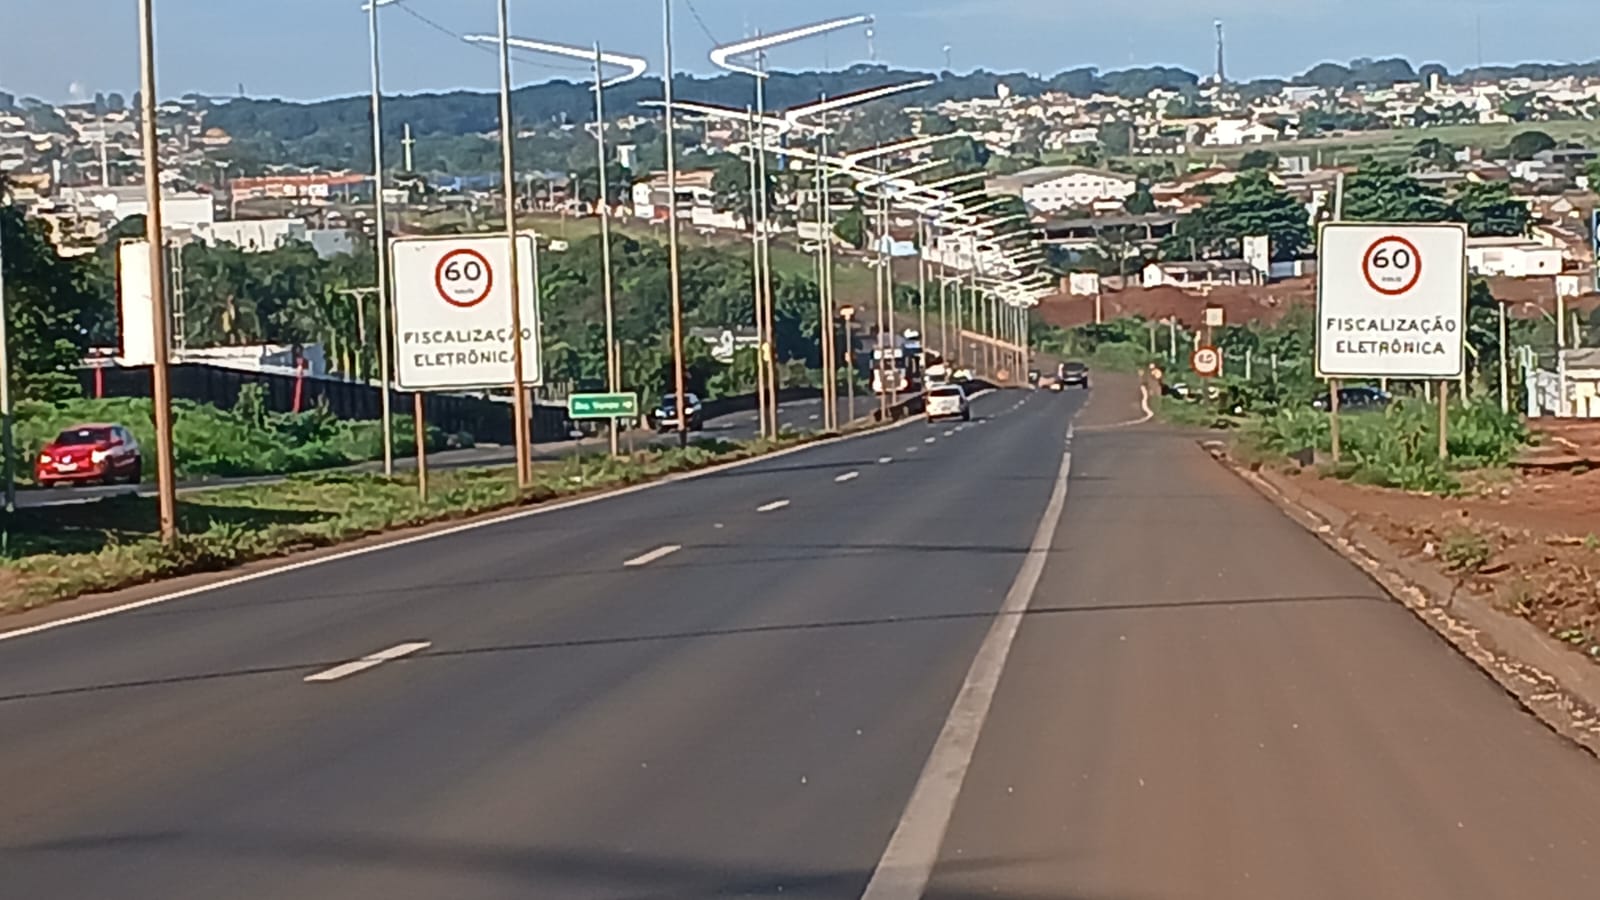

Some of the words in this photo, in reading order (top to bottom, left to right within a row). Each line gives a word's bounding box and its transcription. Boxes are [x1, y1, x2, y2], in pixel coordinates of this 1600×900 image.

[1372, 248, 1410, 269] 60
[445, 261, 481, 281] 60
[1326, 315, 1457, 335] FISCALIZAÇÃO
[1335, 338, 1446, 356] ELETRÔNICA
